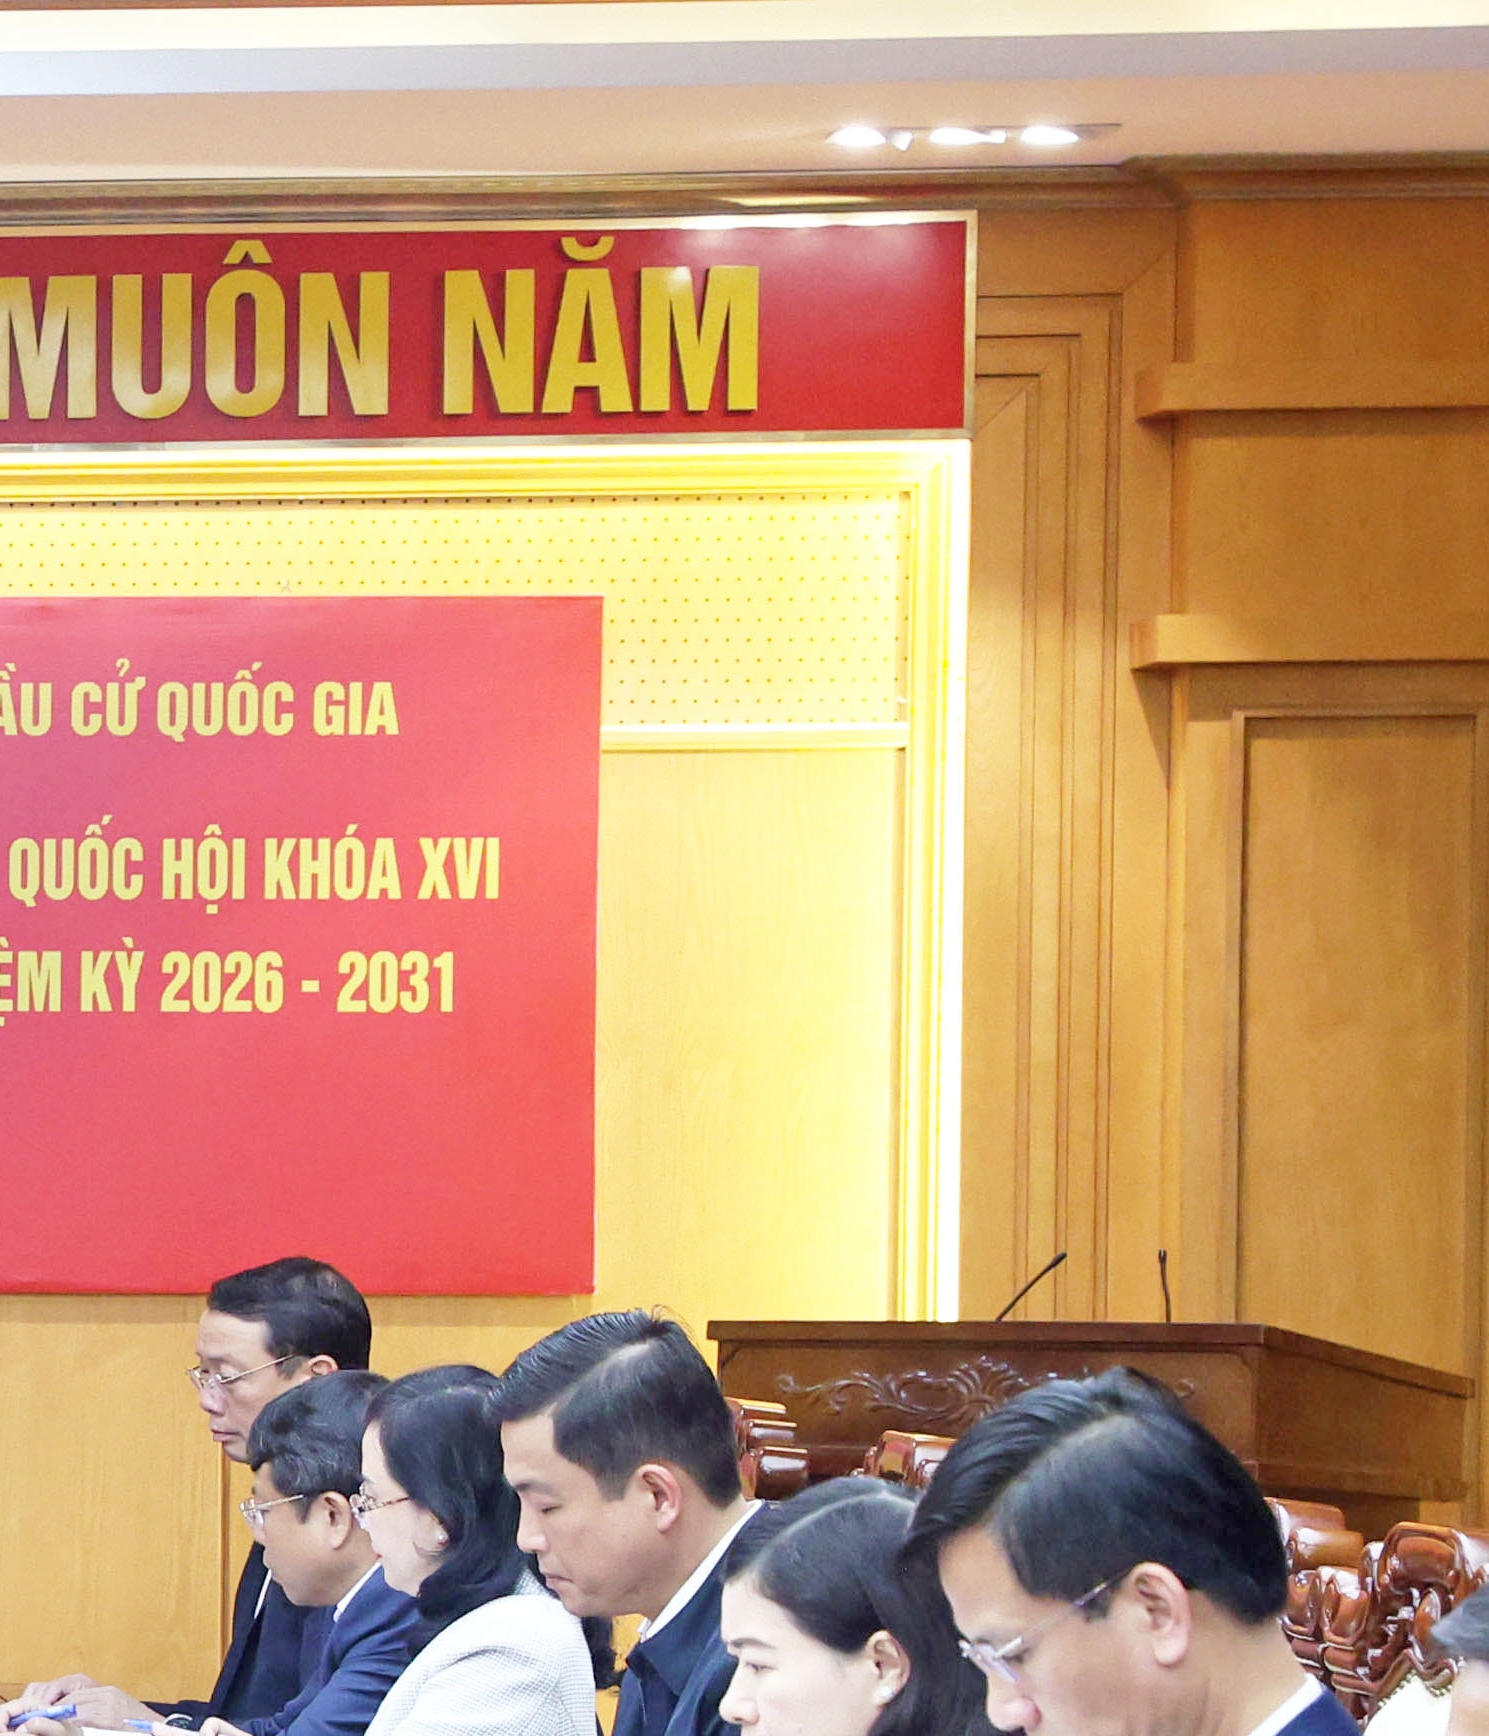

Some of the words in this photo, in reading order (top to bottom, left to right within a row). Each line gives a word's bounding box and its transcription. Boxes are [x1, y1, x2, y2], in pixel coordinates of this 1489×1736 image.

[443, 236, 760, 415] NĂM
[70, 657, 147, 737] CỬ
[156, 661, 295, 743] QUỐC
[312, 681, 400, 737] GIA
[8, 814, 144, 908] QUỐC
[162, 823, 246, 915] HỘI
[264, 823, 402, 901] KHÓA
[417, 836, 501, 900] XVI
[80, 936, 145, 1012] KỲ
[160, 950, 284, 1014] 2026
[301, 979, 320, 993] -
[336, 950, 454, 1014] 2031
